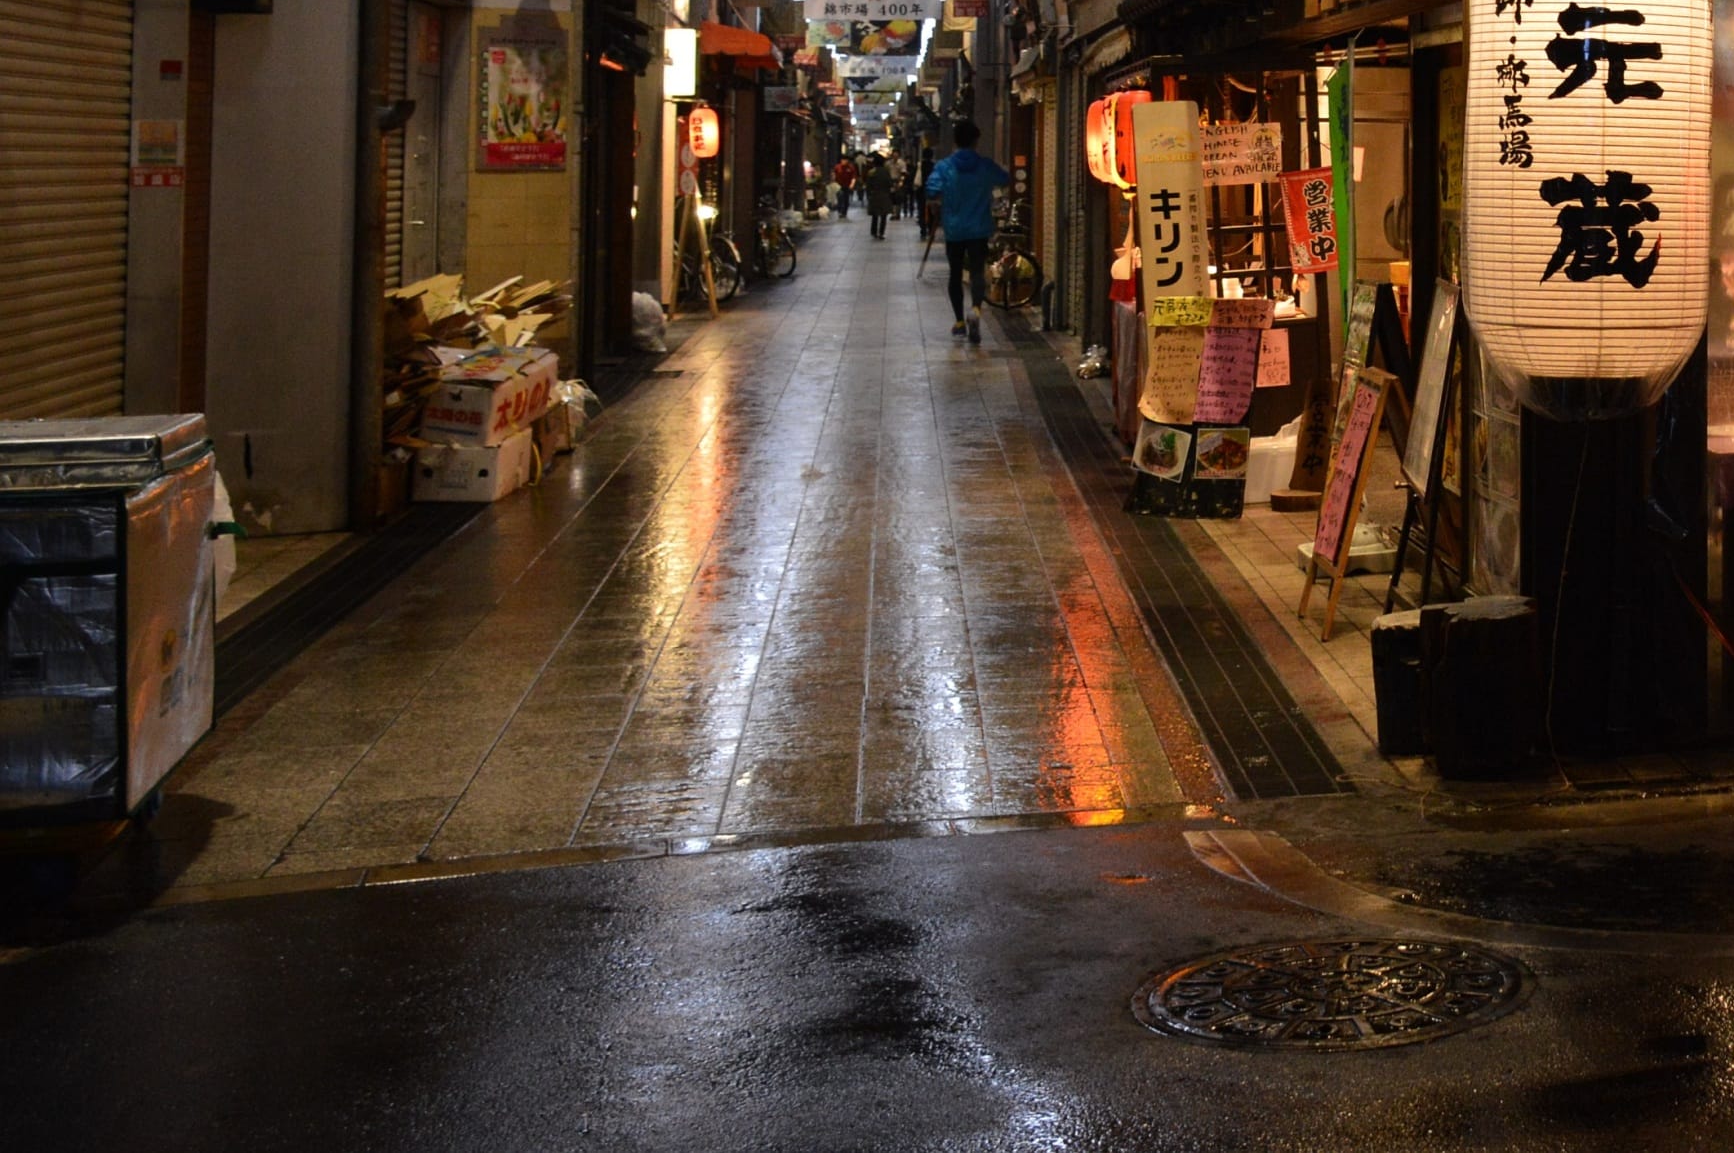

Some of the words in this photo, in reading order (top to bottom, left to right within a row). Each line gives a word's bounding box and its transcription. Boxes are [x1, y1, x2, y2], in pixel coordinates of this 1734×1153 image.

[1203, 138, 1241, 150] HINESE
[1539, 3, 1664, 289] 元蔵
[1150, 189, 1184, 288] キリン
[1303, 179, 1337, 263] 営業中
